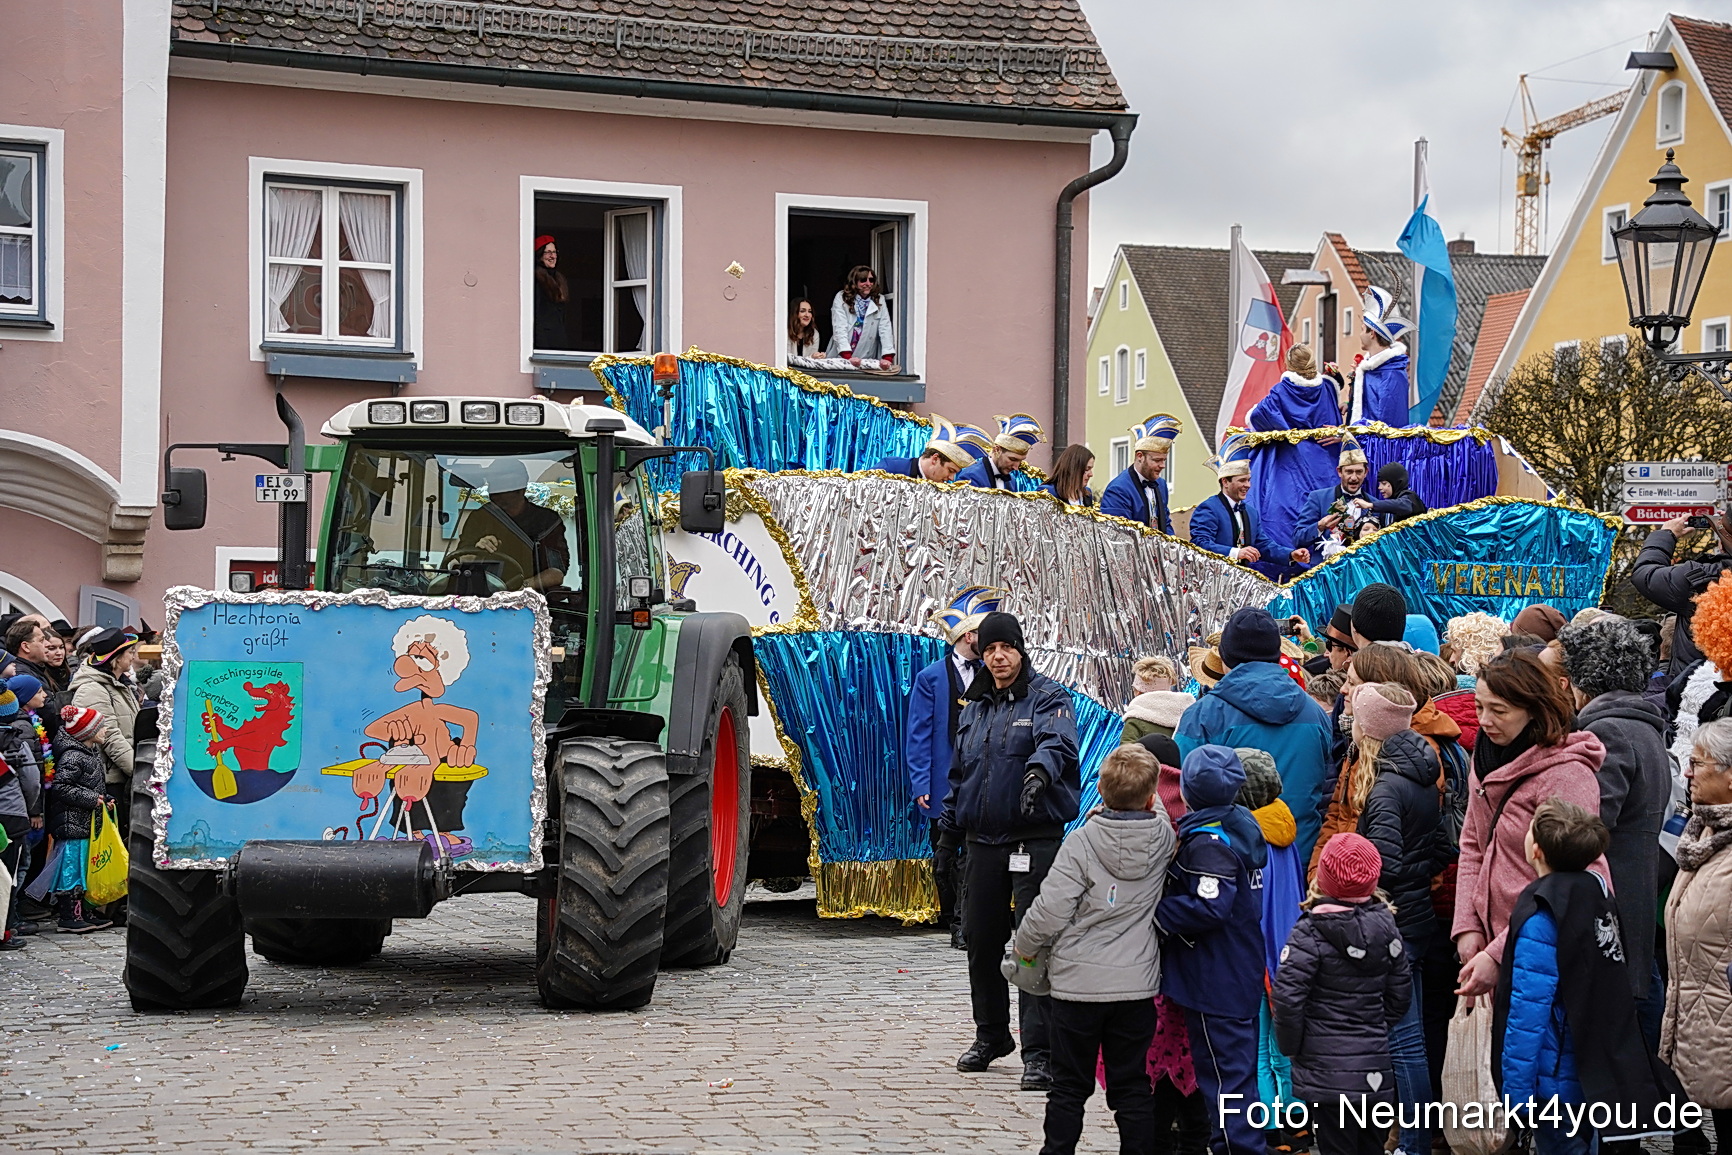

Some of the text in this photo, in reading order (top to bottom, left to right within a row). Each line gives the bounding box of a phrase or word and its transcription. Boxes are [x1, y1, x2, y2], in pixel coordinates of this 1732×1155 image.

[266, 476, 281, 488] EI
[1661, 466, 1714, 479] Europahalle
[263, 489, 298, 500] FT 99
[1639, 488, 1698, 497] Eine-Welt-Laden
[1433, 563, 1565, 597] VERENA II
[214, 603, 301, 626] Hechtonia
[243, 628, 289, 655] grüßt
[203, 667, 283, 688] Faschingsgilde
[194, 686, 240, 714] Obernberg
[213, 705, 239, 724] am Inn
